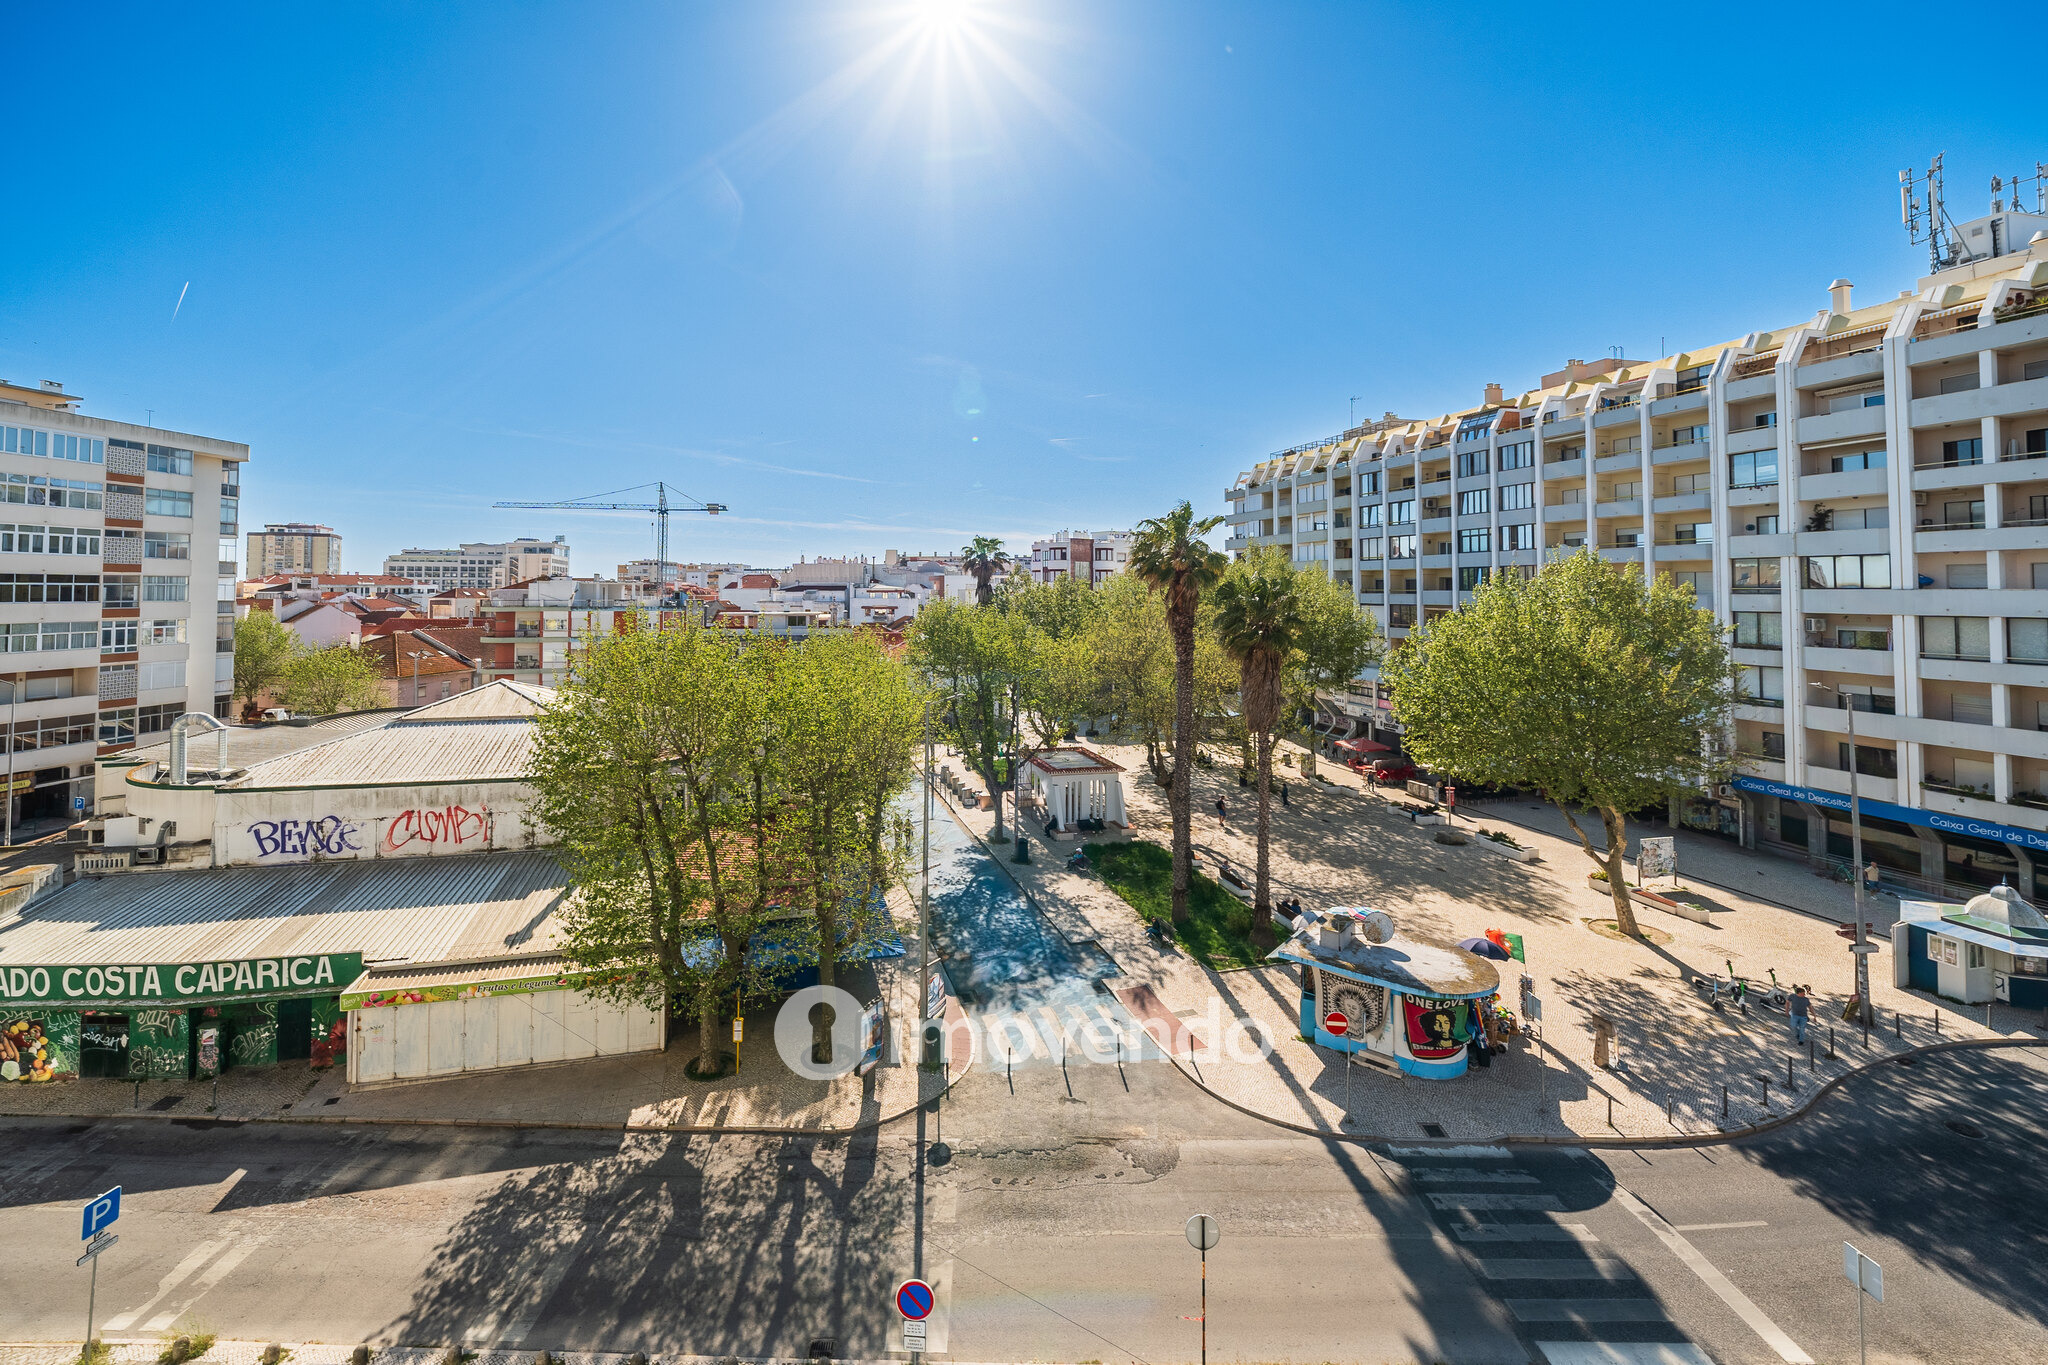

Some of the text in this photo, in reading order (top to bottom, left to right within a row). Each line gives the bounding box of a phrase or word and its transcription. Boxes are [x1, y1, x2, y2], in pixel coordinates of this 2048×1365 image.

[1741, 779, 1765, 791] Caixa
[1767, 784, 1791, 796] Geral
[1793, 791, 1805, 799] de
[76, 799, 82, 808] P
[1930, 816, 1963, 831] Caixa
[1968, 823, 2002, 838] Geral
[2006, 832, 2023, 842] de
[62, 965, 162, 997] COSTA
[175, 956, 335, 995] CAPARICA
[477, 983, 509, 993] Frutas
[1406, 993, 1465, 1010] ONE LOVE
[91, 1198, 112, 1232] P
